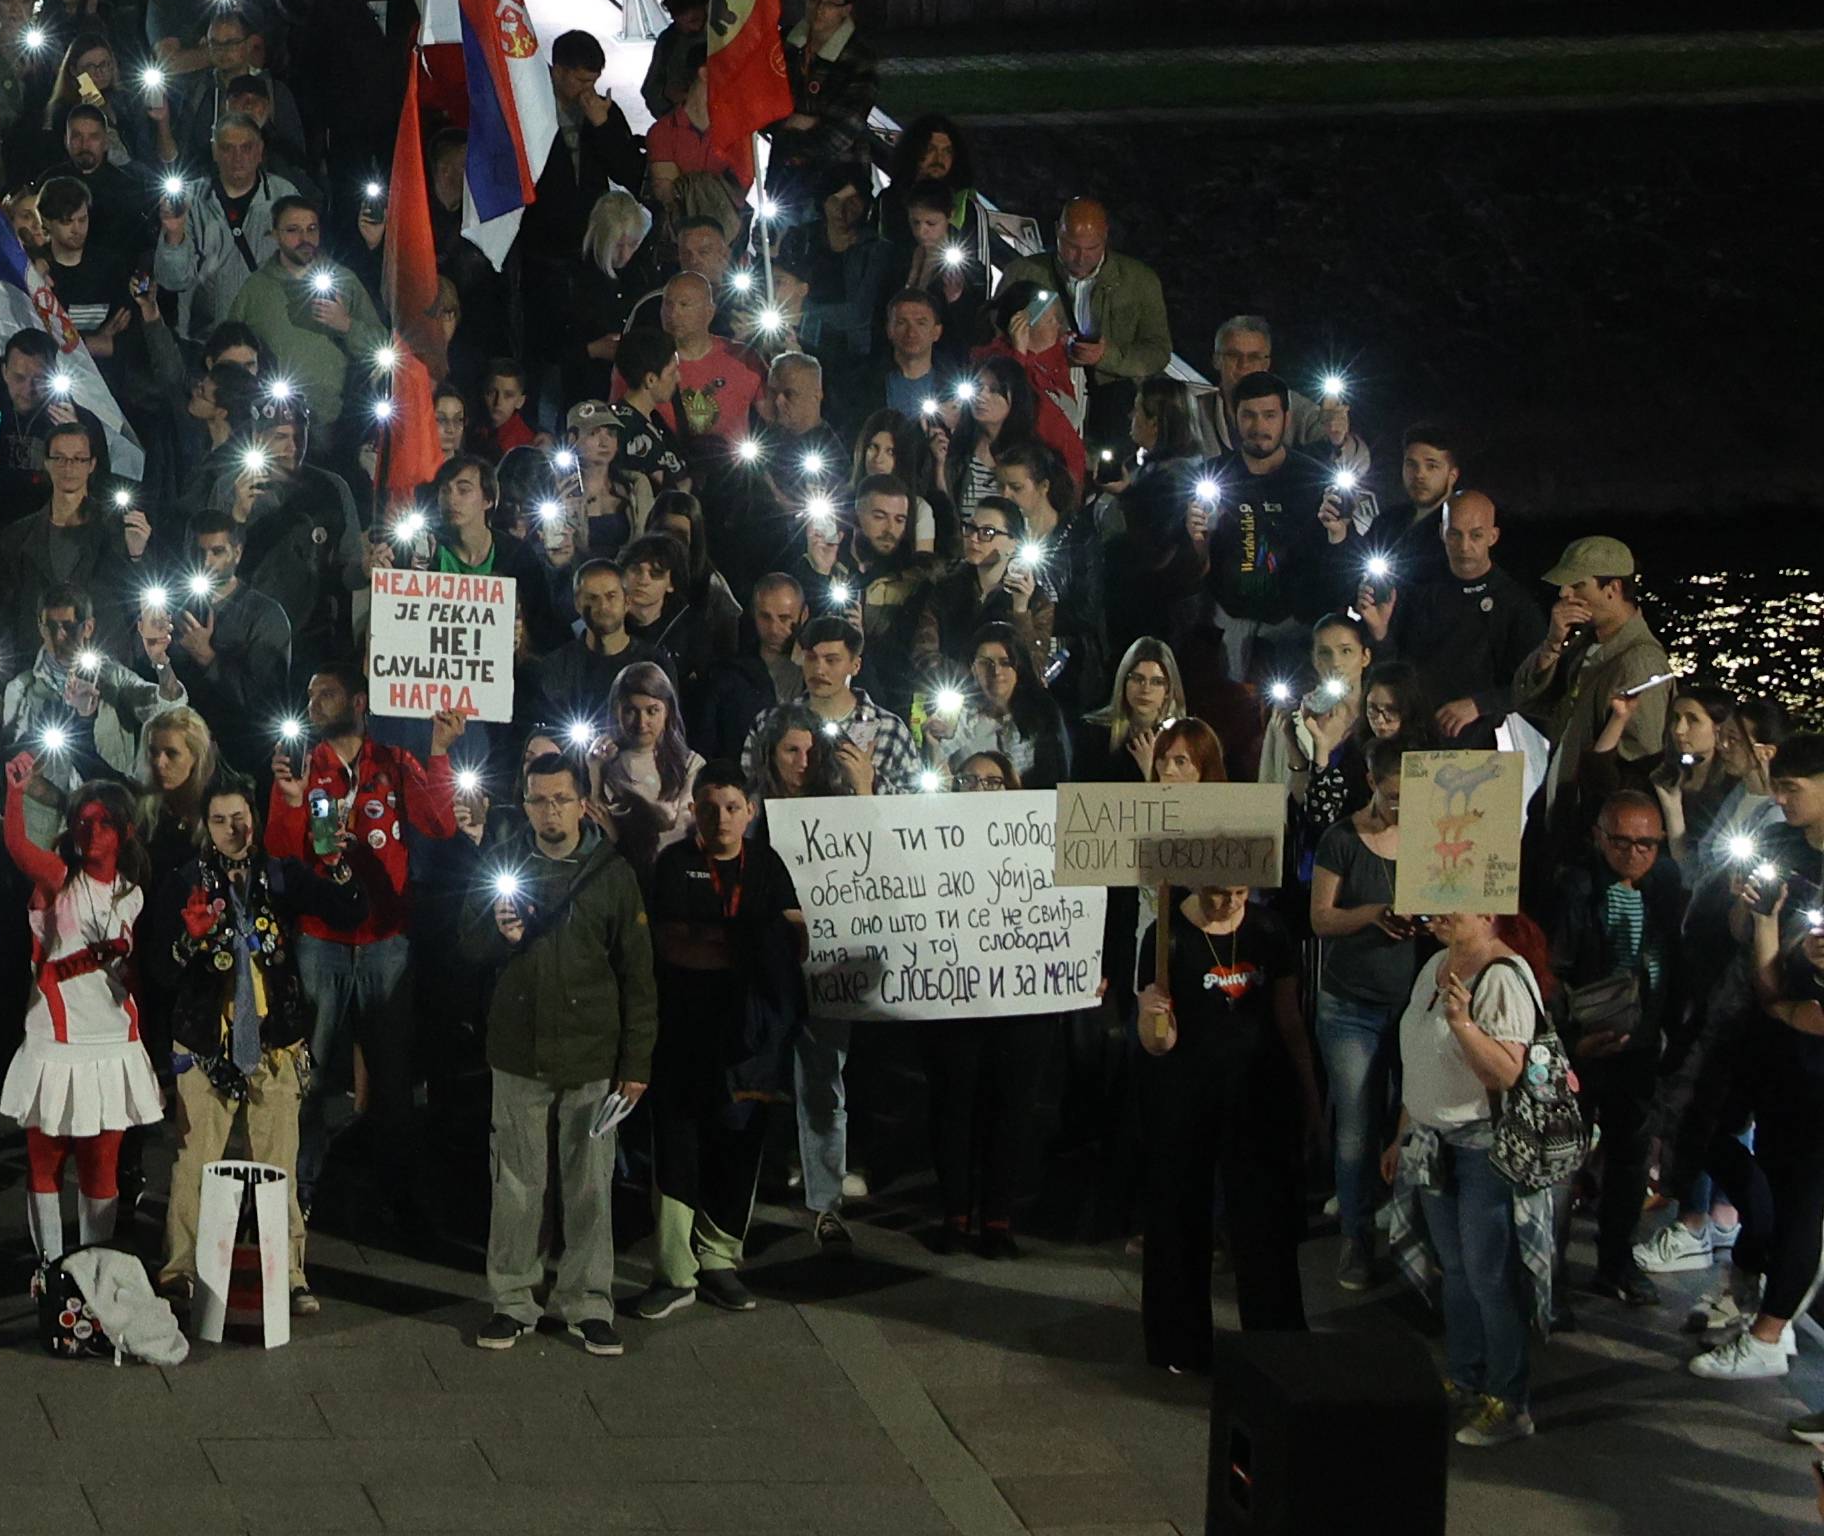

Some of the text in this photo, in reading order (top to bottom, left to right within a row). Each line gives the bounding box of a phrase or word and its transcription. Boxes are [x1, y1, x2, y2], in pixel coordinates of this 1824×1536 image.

[374, 572, 504, 604] МЕДИЈАНА
[394, 603, 496, 626] ЈЕ РЕКЛА
[373, 655, 495, 683] СЛУШАЈТЕ
[389, 683, 480, 716] НАРОД
[892, 827, 927, 851] ти
[935, 825, 965, 849] то
[1063, 839, 1118, 870] КОЈИ
[1127, 838, 1152, 869] ЈЕ
[1158, 838, 1203, 869] ОВО
[810, 856, 1056, 906] обећаваш ако убија
[811, 918, 838, 939] за
[851, 915, 883, 936] оно
[889, 913, 927, 933] што
[936, 909, 960, 929] ти
[968, 908, 990, 928] се
[1002, 907, 1022, 925] не
[811, 947, 848, 963] има
[865, 945, 889, 961] ли
[929, 932, 959, 965] тој
[979, 926, 1071, 954] слободи
[1013, 964, 1036, 996] за
